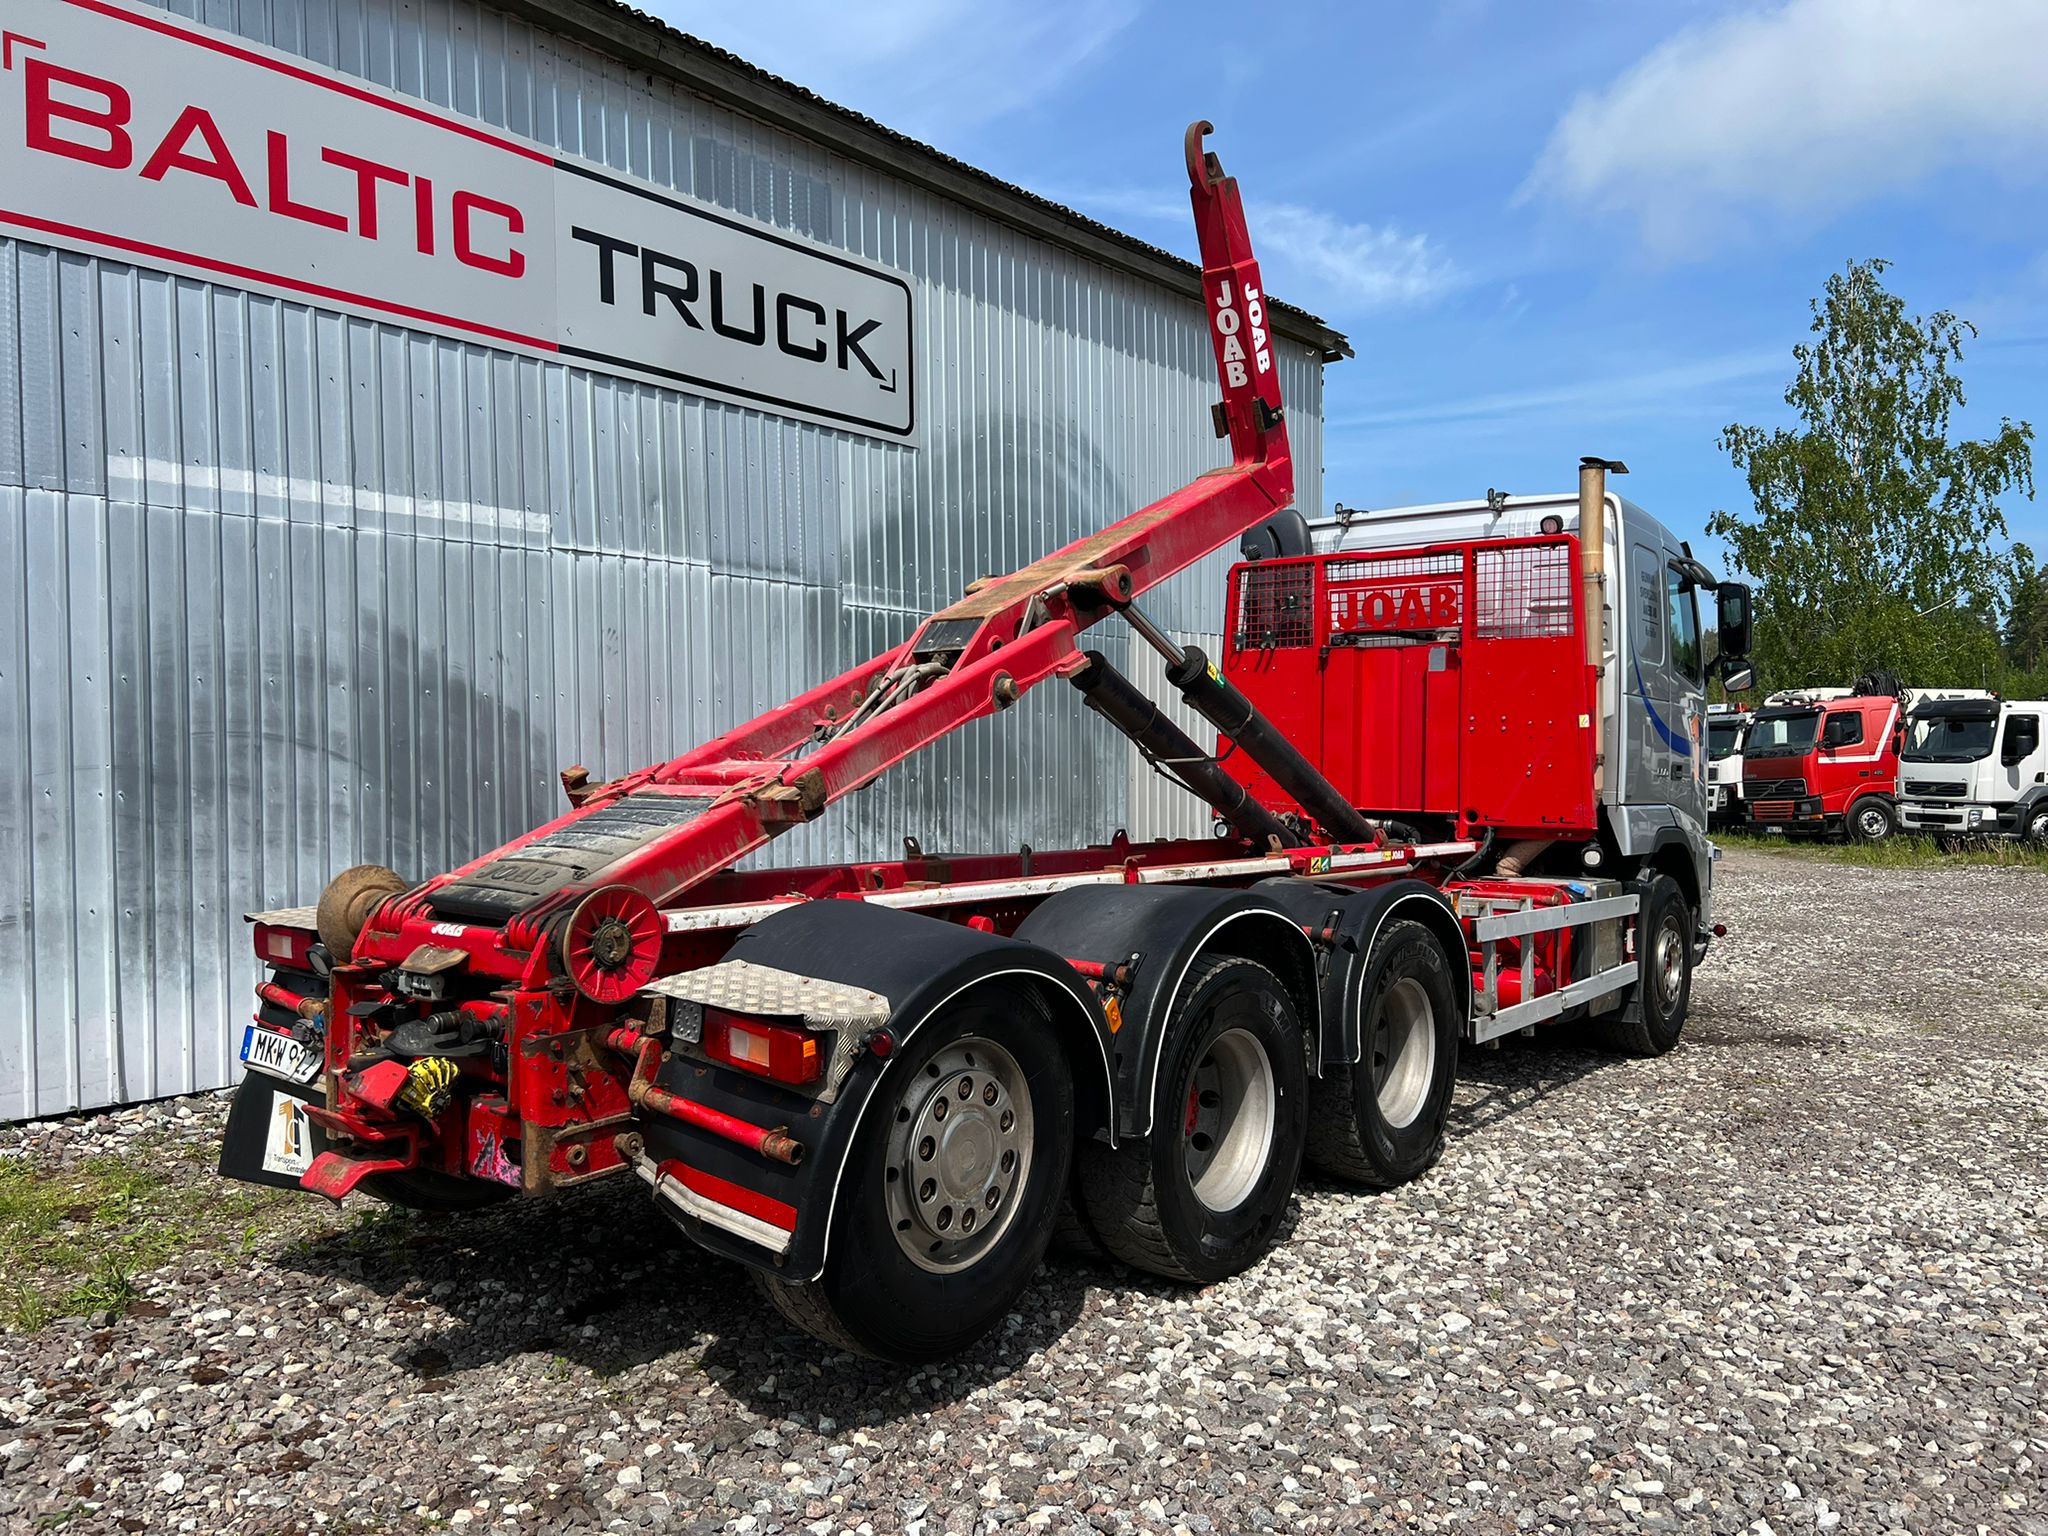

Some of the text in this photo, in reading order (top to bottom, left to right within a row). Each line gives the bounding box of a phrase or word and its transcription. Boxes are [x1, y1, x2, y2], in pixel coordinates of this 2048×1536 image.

[25, 56, 888, 381] BALTIC TRUCK
[1216, 279, 1249, 389] JOAB
[1244, 281, 1271, 375] JOAB
[1337, 585, 1459, 631] JOAB
[475, 864, 558, 886] JOAB
[431, 923, 468, 937] JOAB
[253, 1033, 288, 1067] MKW
